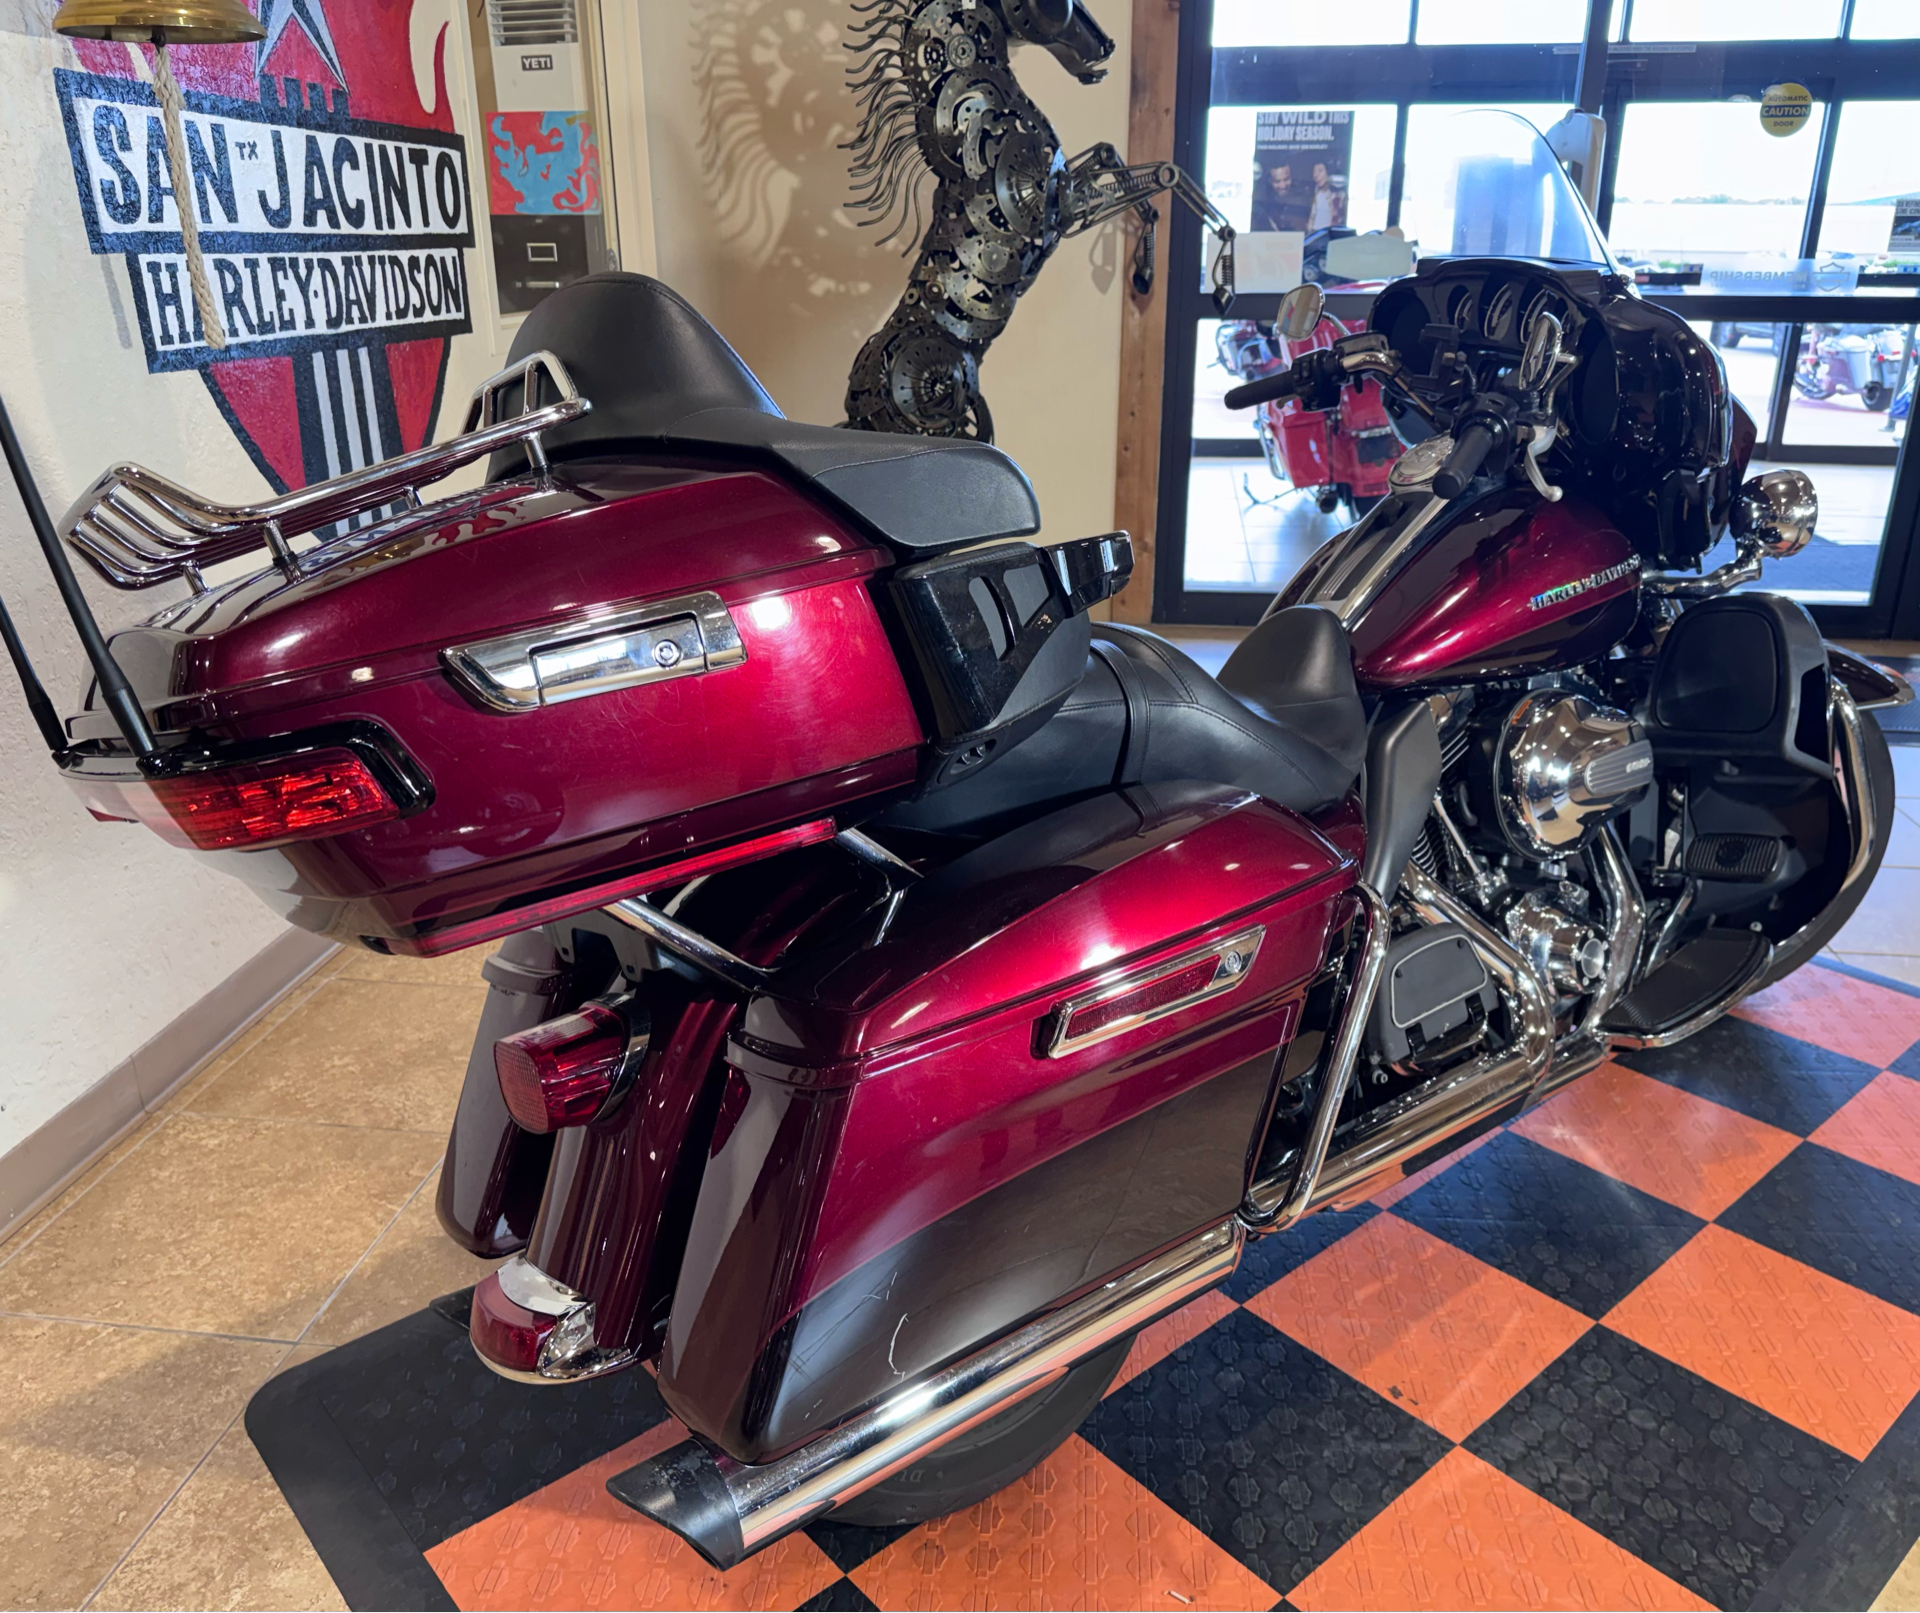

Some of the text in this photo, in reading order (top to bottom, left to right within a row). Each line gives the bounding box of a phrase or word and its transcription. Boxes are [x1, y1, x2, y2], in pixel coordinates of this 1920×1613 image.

[522, 57, 551, 69] YETI
[1281, 111, 1327, 124] WILD
[1762, 106, 1810, 116] CAUTION
[1257, 125, 1295, 141] HOLIDAY
[235, 140, 258, 160] TX
[93, 105, 462, 231] SAN JACINTO
